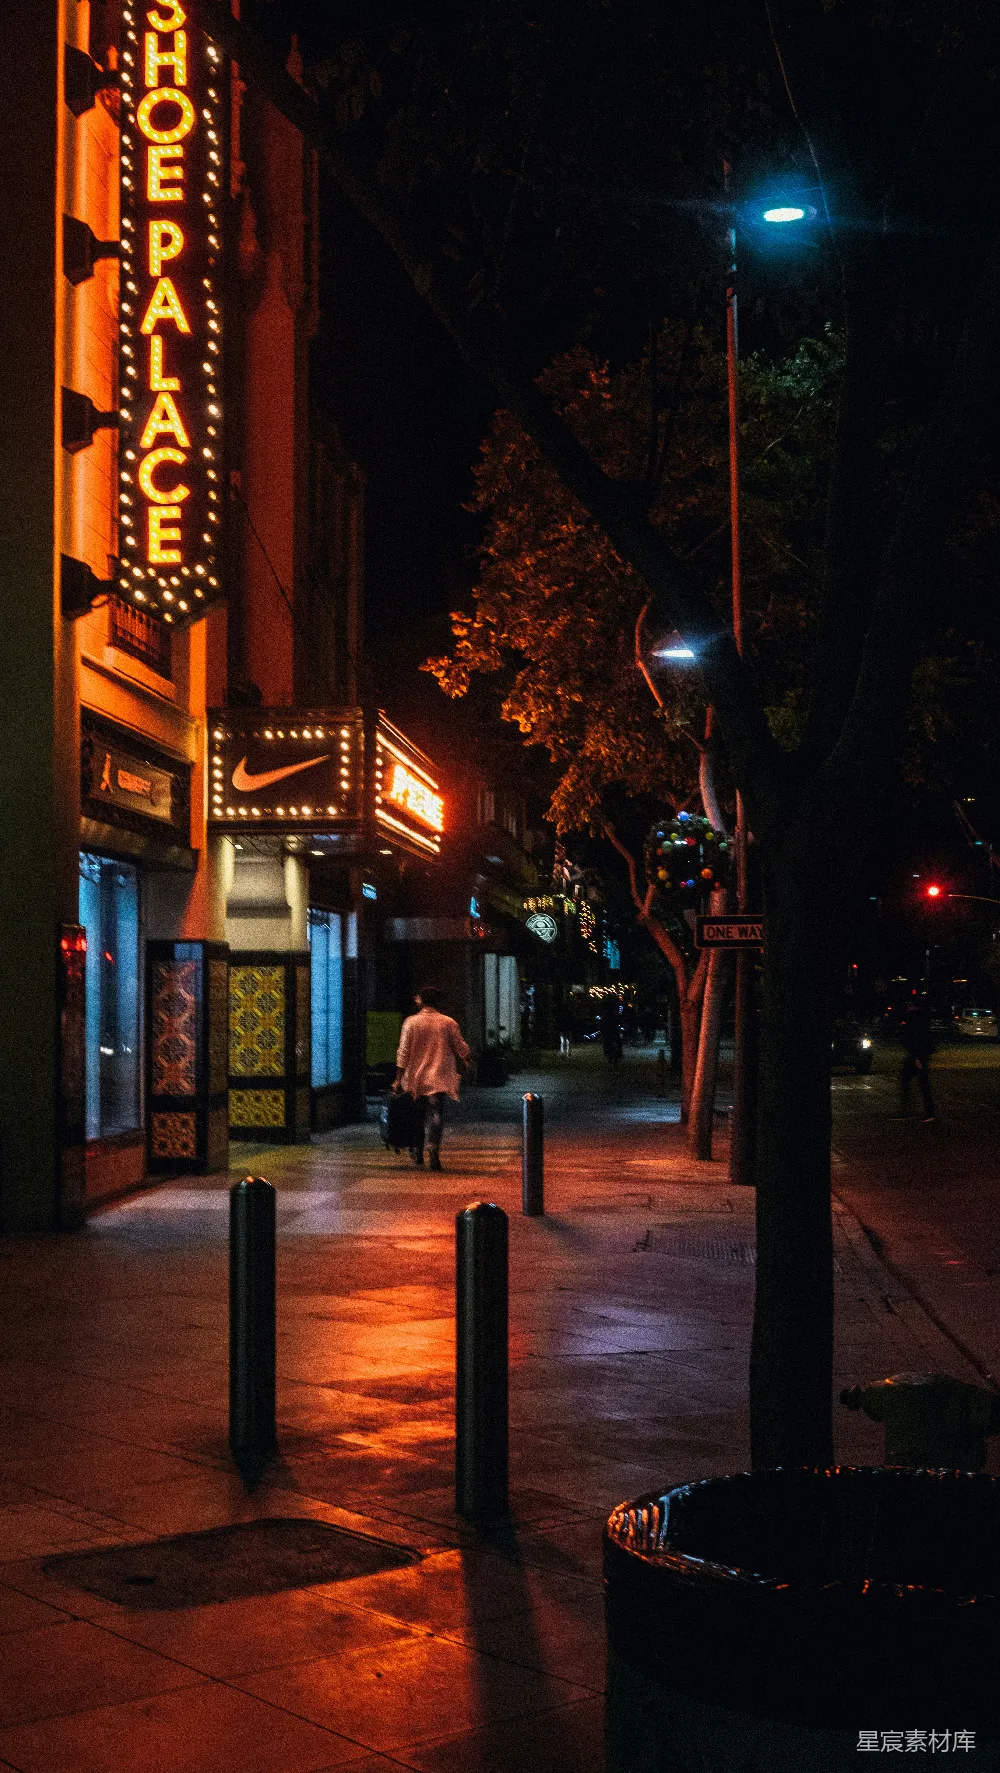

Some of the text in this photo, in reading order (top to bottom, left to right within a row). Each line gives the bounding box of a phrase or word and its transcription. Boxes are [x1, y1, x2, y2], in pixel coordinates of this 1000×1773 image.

[137, 0, 195, 563] SHOE PALACE
[707, 926, 734, 939] ONE
